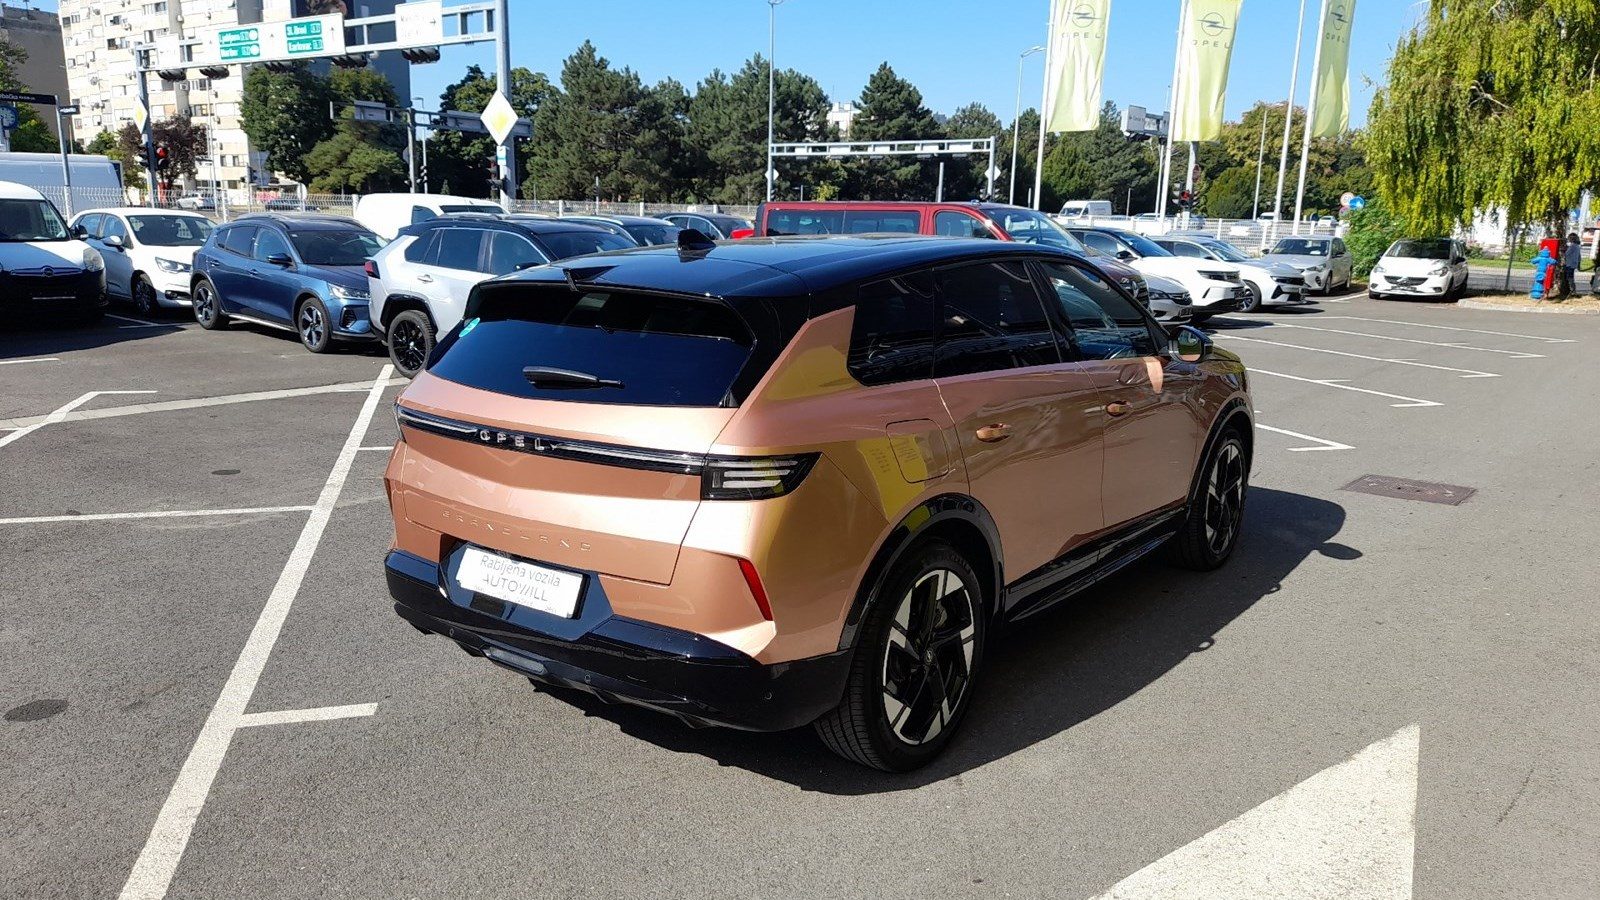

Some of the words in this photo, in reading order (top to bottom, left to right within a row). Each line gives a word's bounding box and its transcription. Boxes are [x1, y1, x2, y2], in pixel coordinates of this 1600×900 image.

[1191, 40, 1230, 48] OPEL
[1326, 32, 1345, 43] OPEL
[480, 430, 545, 451] OPEL
[480, 555, 526, 578] Rabljena
[529, 569, 561, 587] vozila
